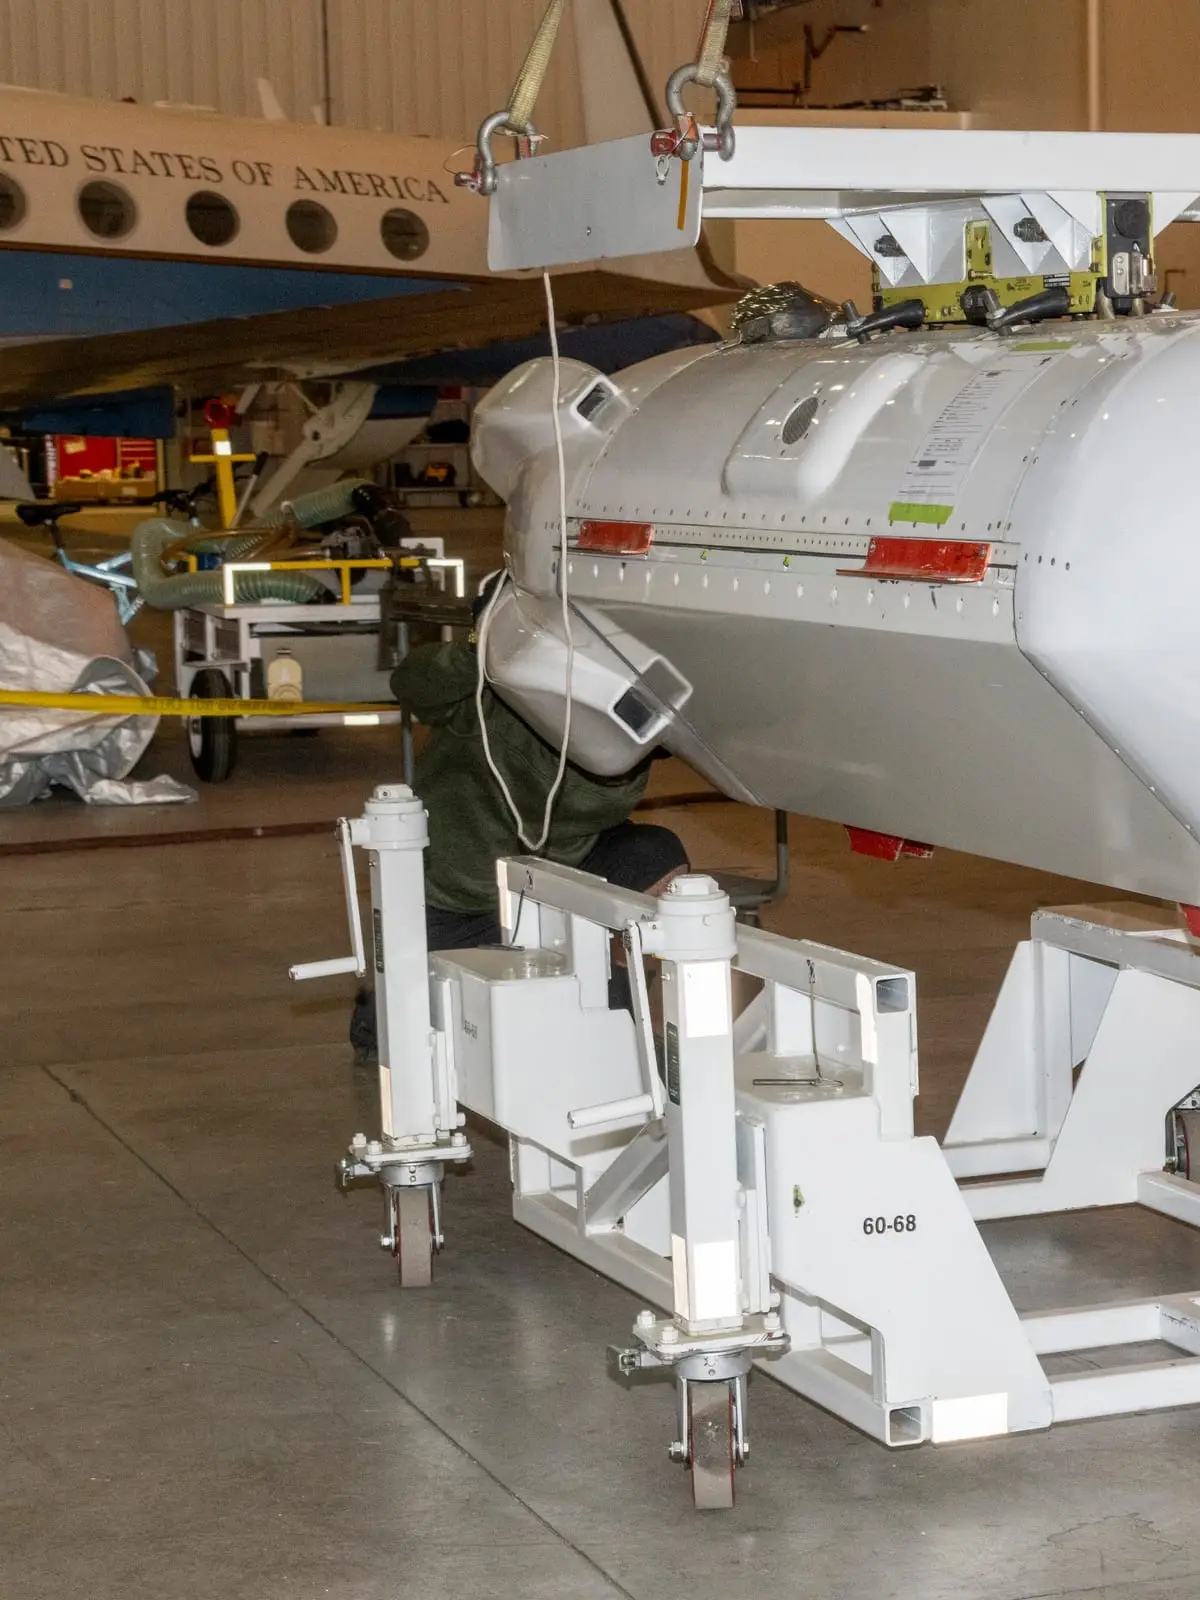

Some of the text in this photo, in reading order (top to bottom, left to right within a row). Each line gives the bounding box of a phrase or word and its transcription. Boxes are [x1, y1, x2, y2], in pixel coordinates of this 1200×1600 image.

[79, 144, 224, 184] STATES
[231, 159, 273, 187] OF
[293, 165, 450, 204] AMERICA
[863, 1214, 917, 1235] 60-68
